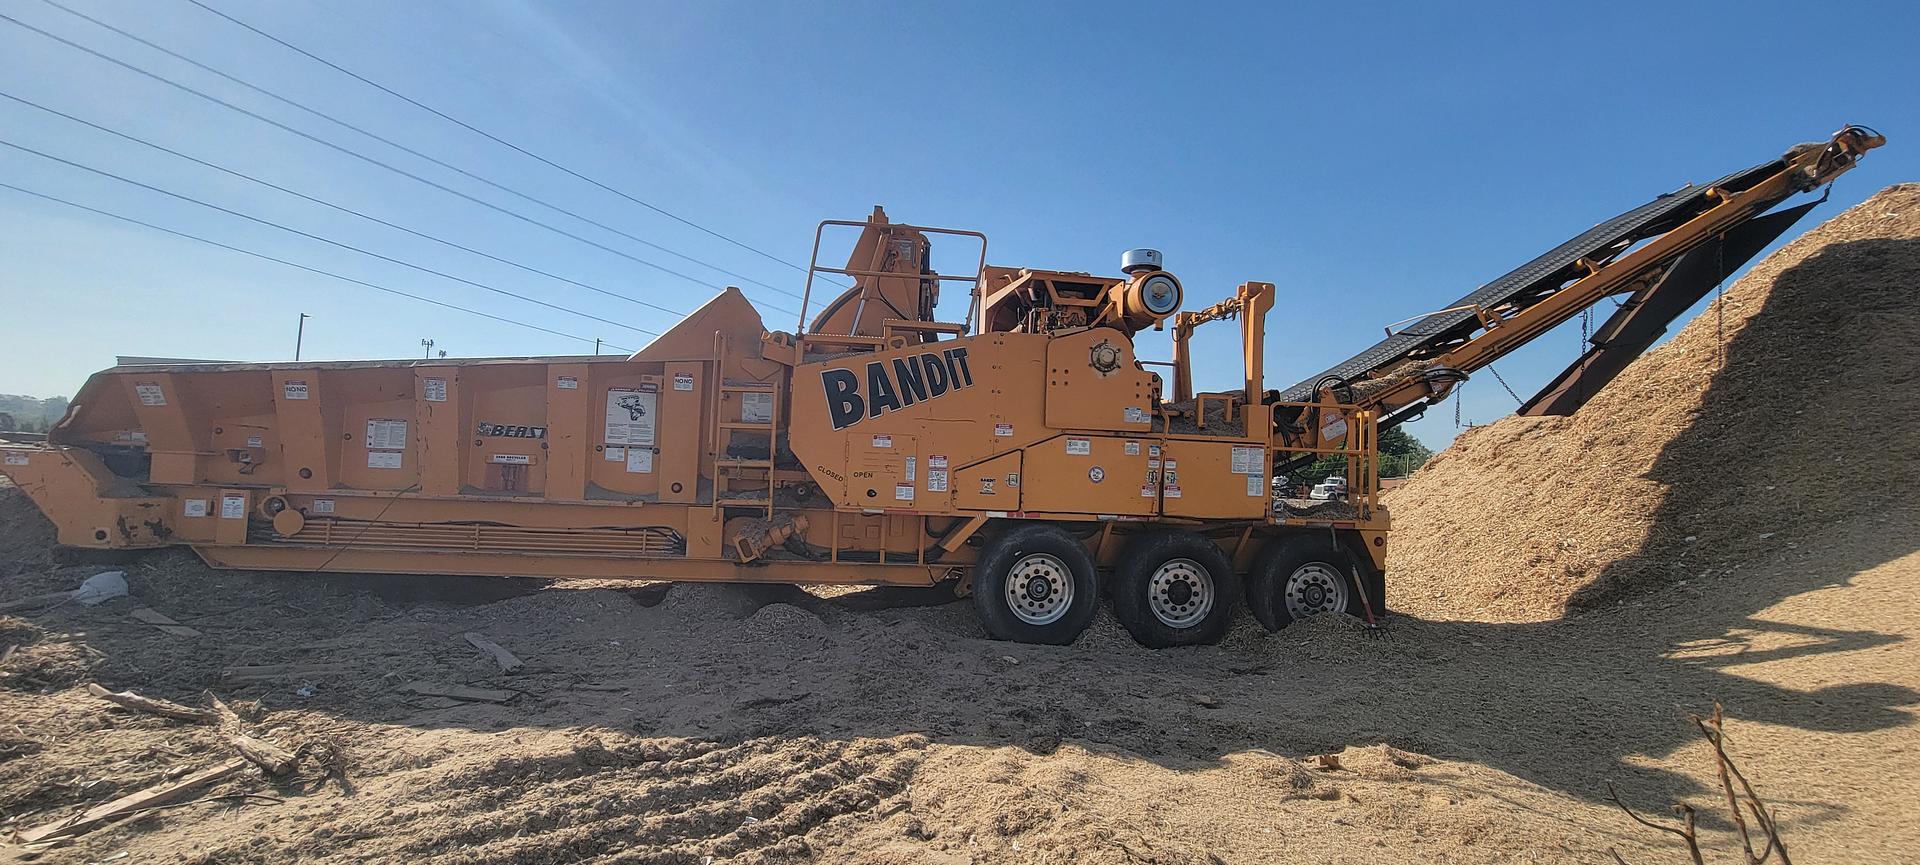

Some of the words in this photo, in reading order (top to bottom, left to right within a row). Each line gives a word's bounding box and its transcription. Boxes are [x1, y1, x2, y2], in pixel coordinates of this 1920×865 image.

[820, 346, 973, 431] BANDIT
[491, 424, 547, 439] BEAST
[817, 465, 844, 482] CLOSED
[853, 471, 874, 479] OPEN
